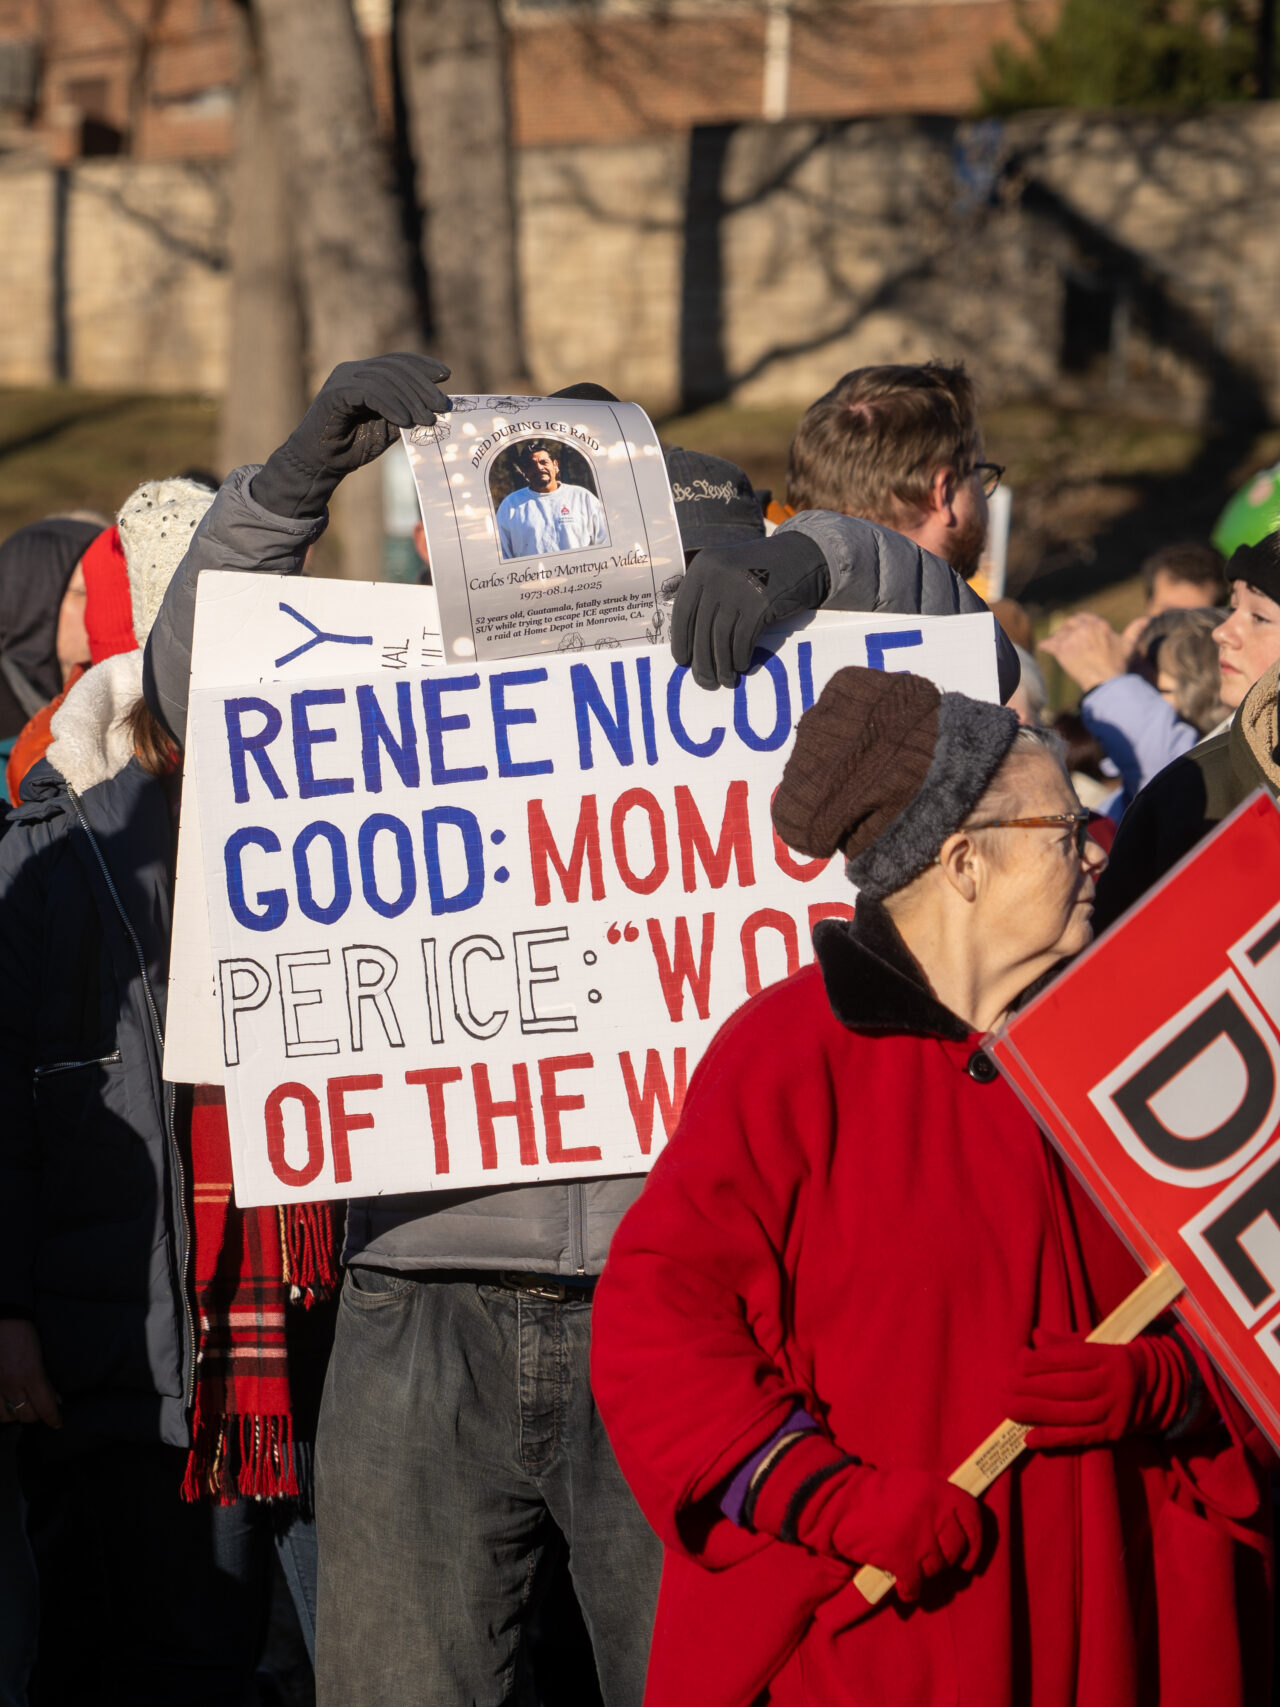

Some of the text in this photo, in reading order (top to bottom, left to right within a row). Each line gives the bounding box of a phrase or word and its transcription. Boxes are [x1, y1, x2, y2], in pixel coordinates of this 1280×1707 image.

[471, 421, 599, 469] DIED DURING ICE RAID
[470, 549, 648, 591] Carlos Roberto Montoya Valdez
[520, 581, 602, 601] 1973-08.14.2025
[475, 592, 652, 625] 52 years old, Guatamala, fatally struck by an
[476, 600, 654, 634] SUV while trying to escape ICE agents during
[494, 631, 511, 641] raid
[513, 629, 522, 638] at
[524, 626, 548, 636] Home
[549, 622, 573, 634] Depot
[576, 620, 584, 628] in
[586, 614, 628, 627] Monrovia,
[630, 610, 645, 619] CA.
[223, 667, 554, 804] RENEE
[224, 806, 510, 931] GOOD:
[527, 780, 756, 906] MOM
[219, 943, 406, 1067] PER
[421, 926, 602, 1045] ICE:
[264, 1074, 383, 1187] OF
[405, 1052, 602, 1175] THE
